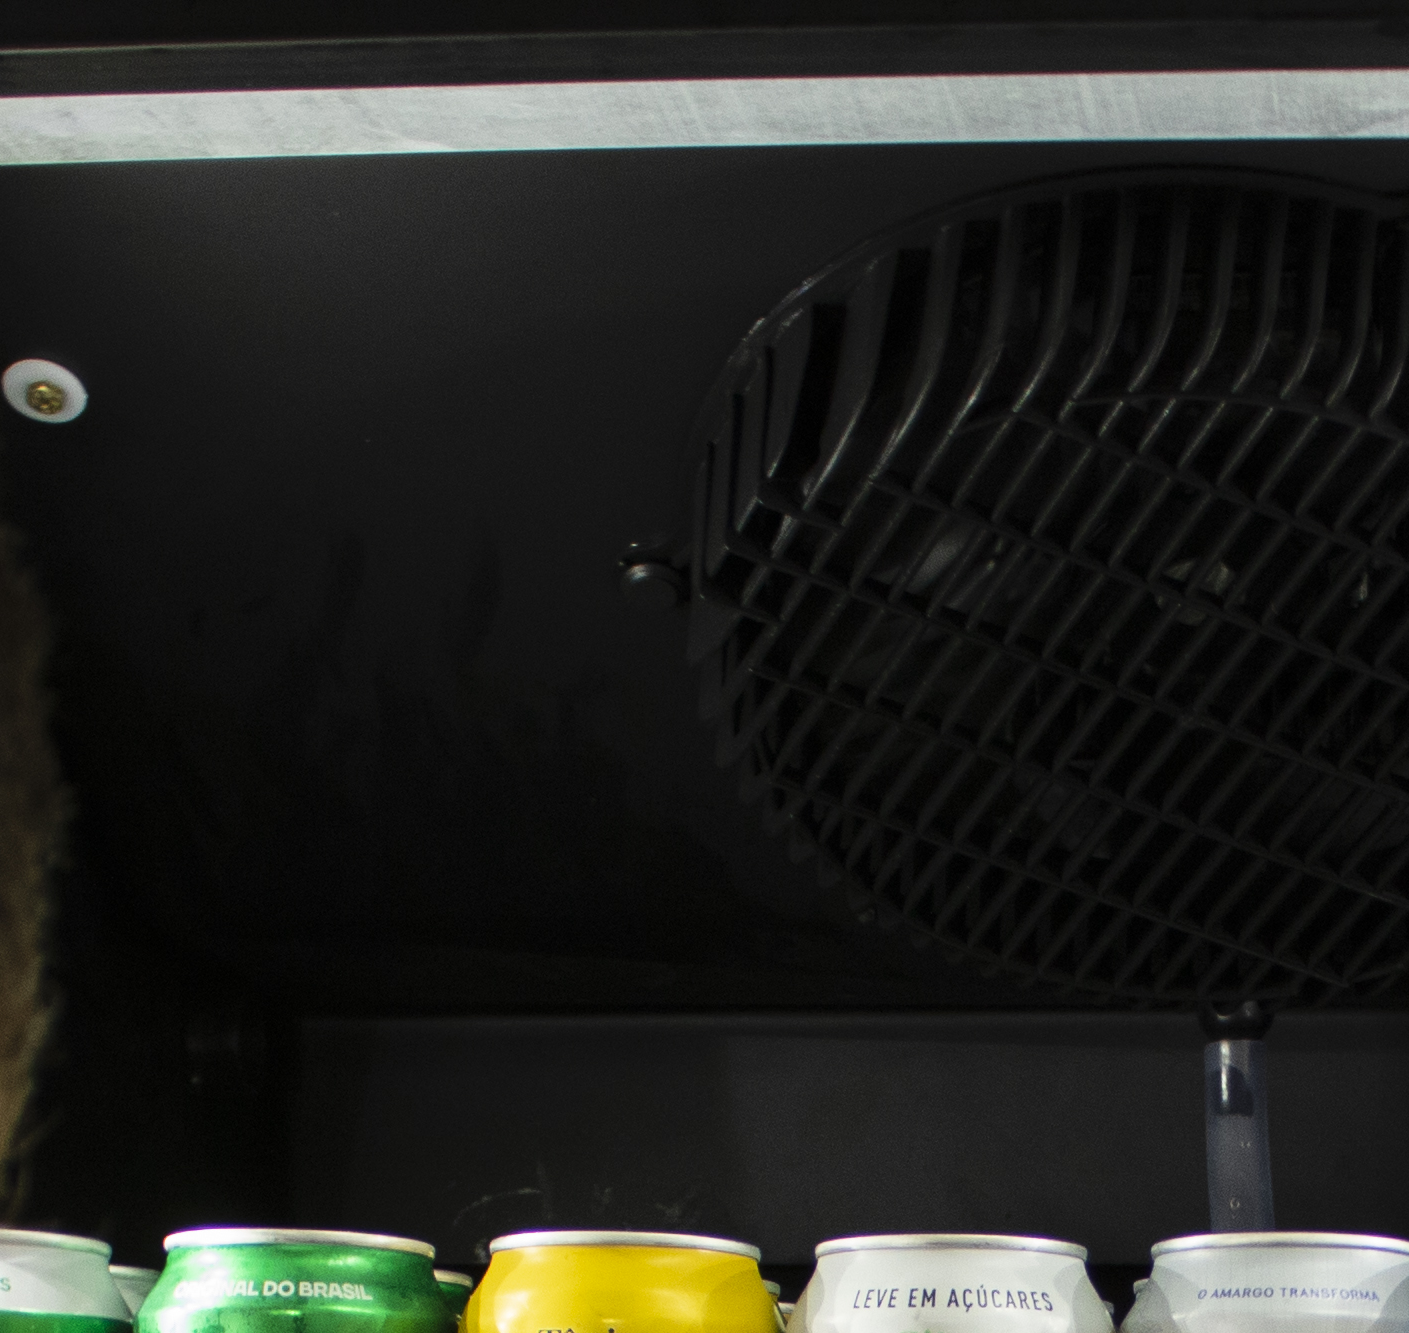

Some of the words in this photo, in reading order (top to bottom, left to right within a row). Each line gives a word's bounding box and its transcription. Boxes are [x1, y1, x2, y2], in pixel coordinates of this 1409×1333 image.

[263, 1279, 295, 1297] DO
[299, 1281, 373, 1300] BRASIL
[853, 1288, 899, 1309] LEVE
[908, 1288, 937, 1308] EM
[947, 1285, 1054, 1313] AÇÚCARES
[1211, 1286, 1274, 1300] AMARGO
[1279, 1286, 1380, 1302] TRANSFORMA
